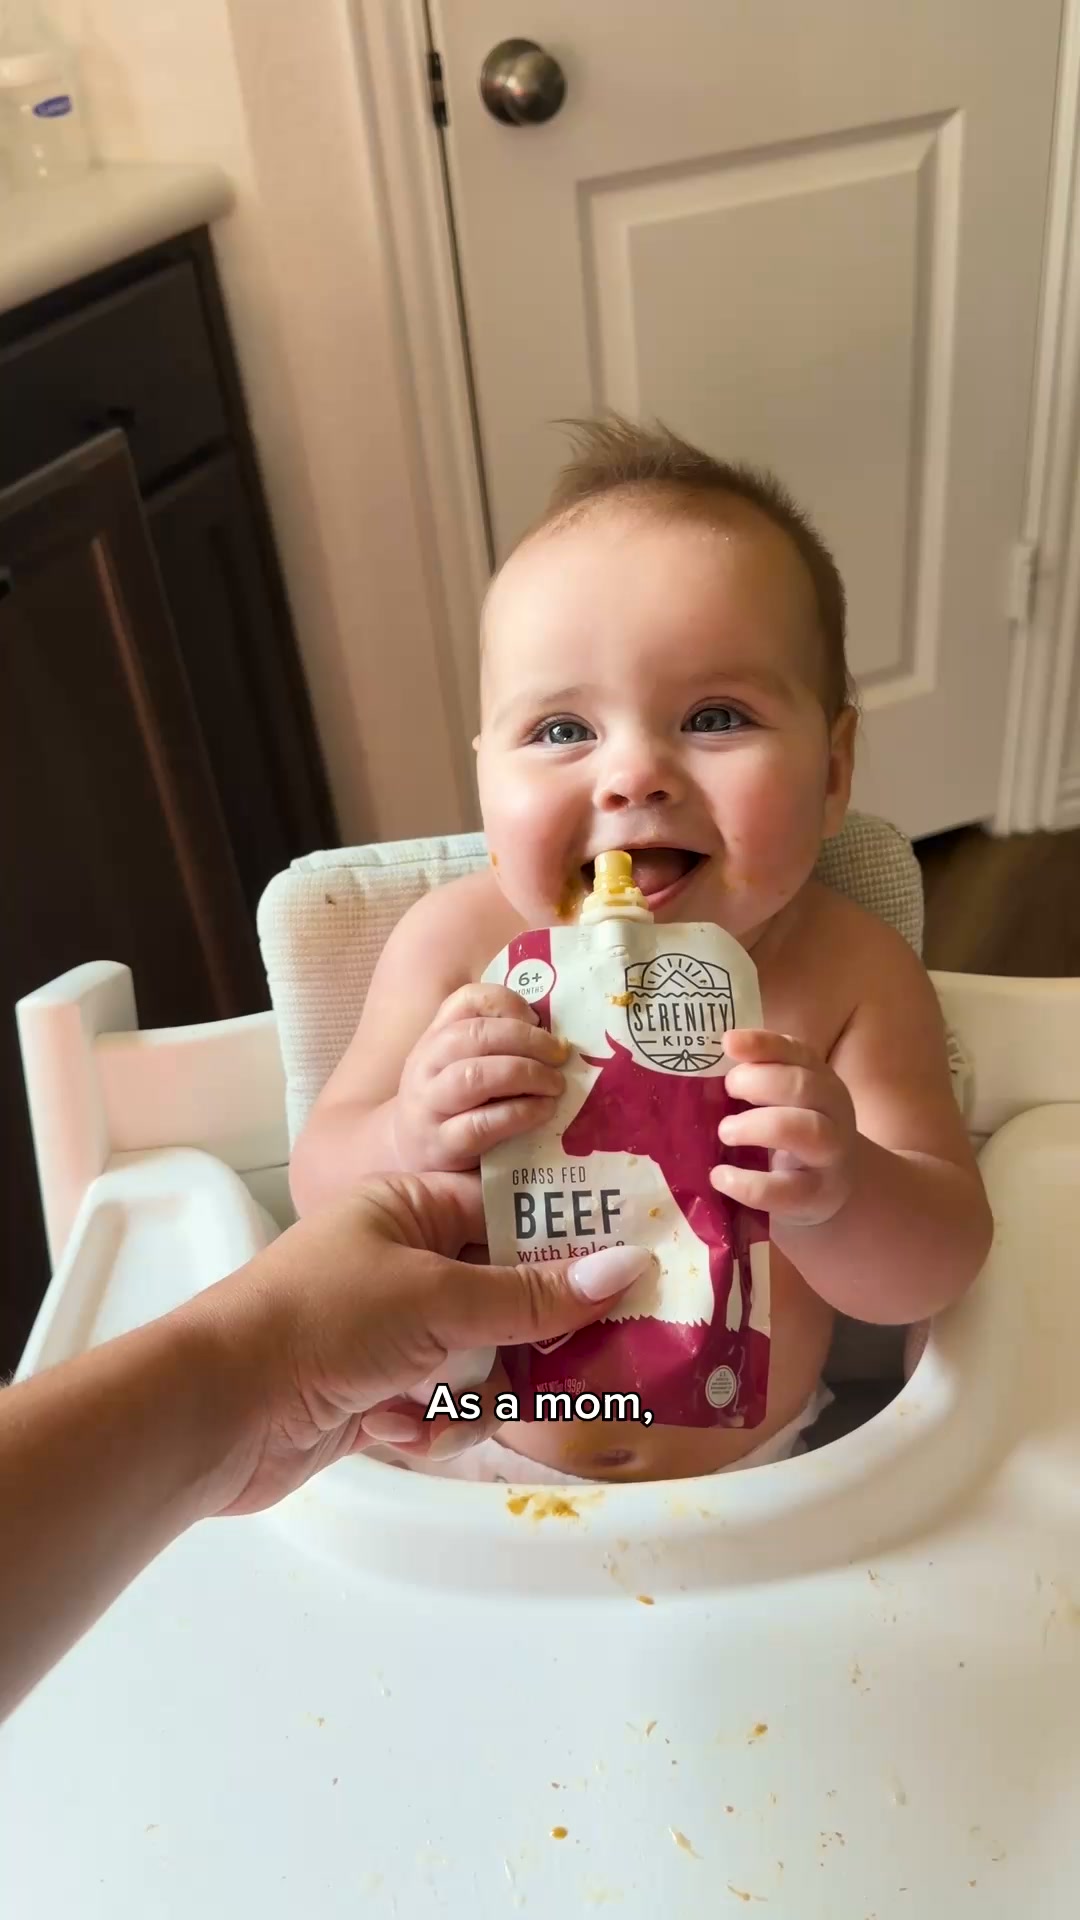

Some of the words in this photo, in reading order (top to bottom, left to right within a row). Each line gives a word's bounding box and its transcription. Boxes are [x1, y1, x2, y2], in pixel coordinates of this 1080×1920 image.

[518, 971, 542, 986] 6+
[633, 1002, 728, 1032] SERENITY
[662, 1035, 706, 1047] KIDS
[512, 1167, 554, 1186] GRASS
[561, 1165, 586, 1184] FED
[513, 1189, 620, 1239] BEEF
[516, 1244, 562, 1263] with
